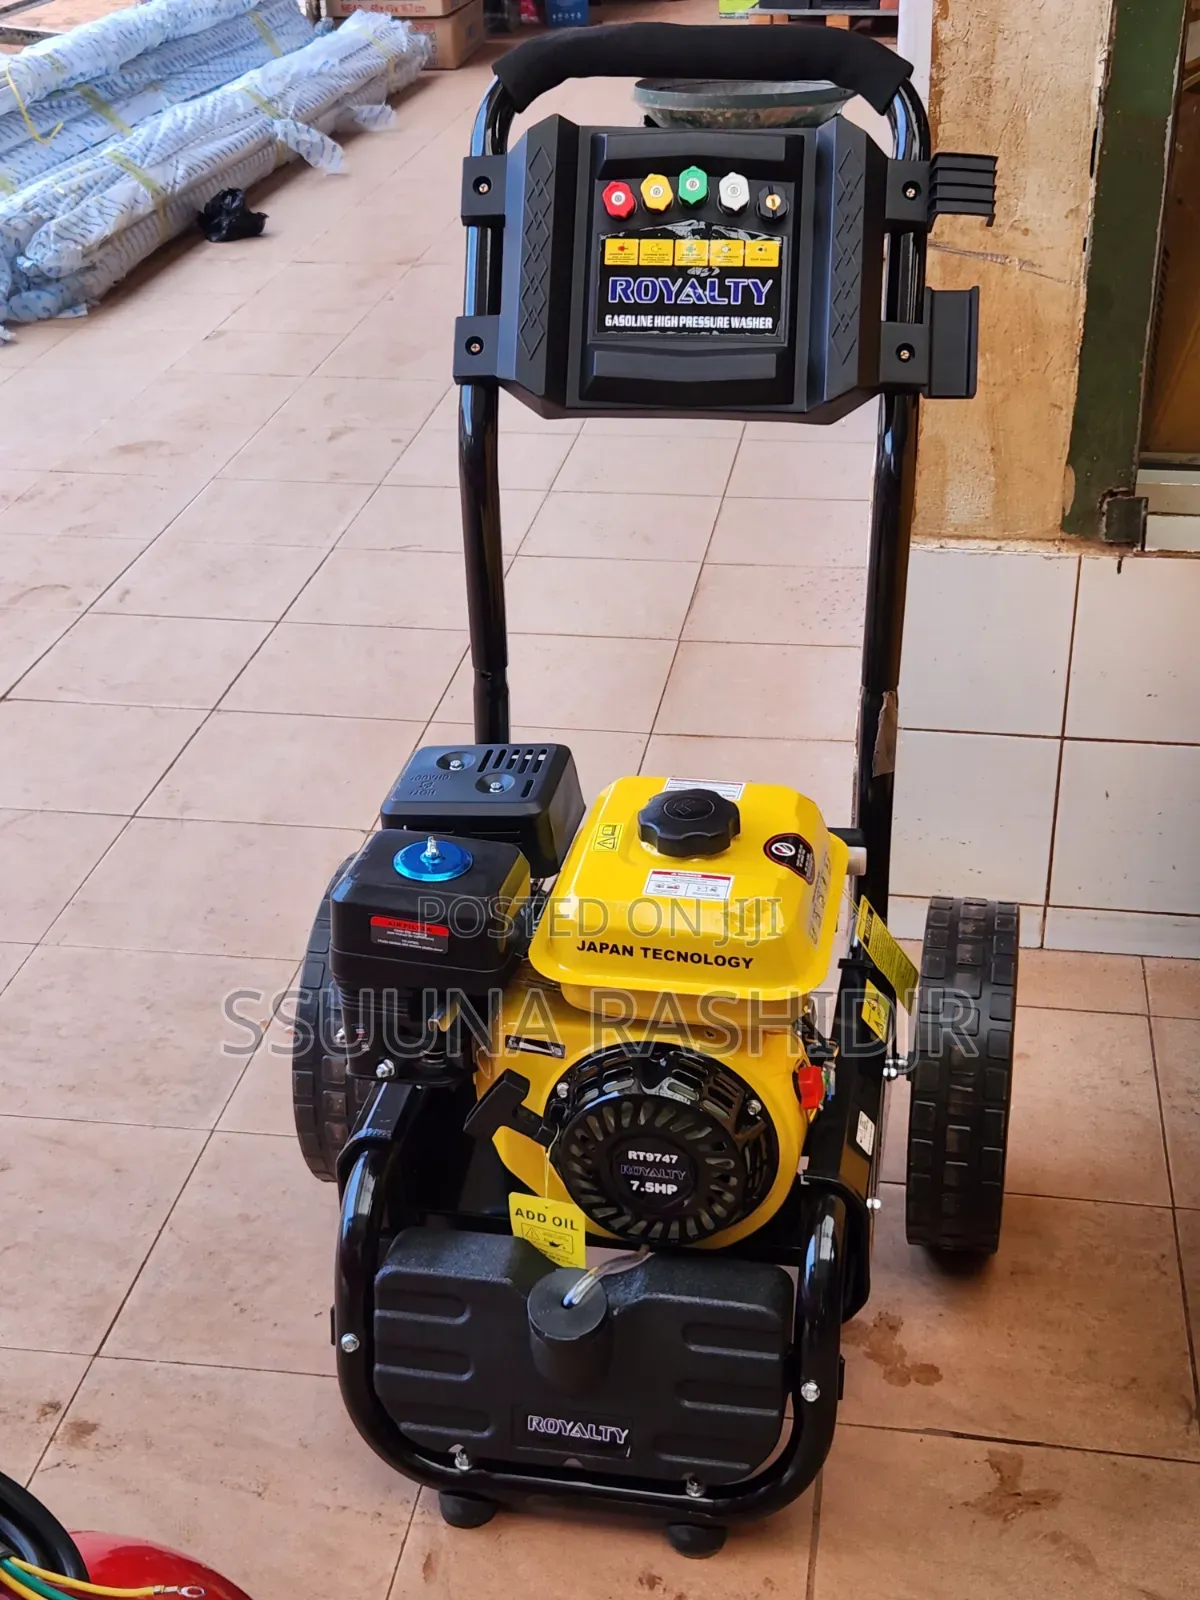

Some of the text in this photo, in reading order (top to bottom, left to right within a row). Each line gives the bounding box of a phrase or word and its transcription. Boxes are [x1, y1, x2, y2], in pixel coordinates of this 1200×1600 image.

[608, 277, 773, 305] ROYALTY
[605, 314, 773, 329] GASOLINE HIGH PRESSURE WASHER
[576, 940, 754, 969] JAPAN TECNOLOGY
[628, 1150, 678, 1164] RT9747
[621, 1165, 686, 1180] ROYALTY
[630, 1180, 678, 1195] 7.5HP
[515, 1208, 579, 1231] ADD OIL
[527, 1415, 629, 1444] ROYALTY
